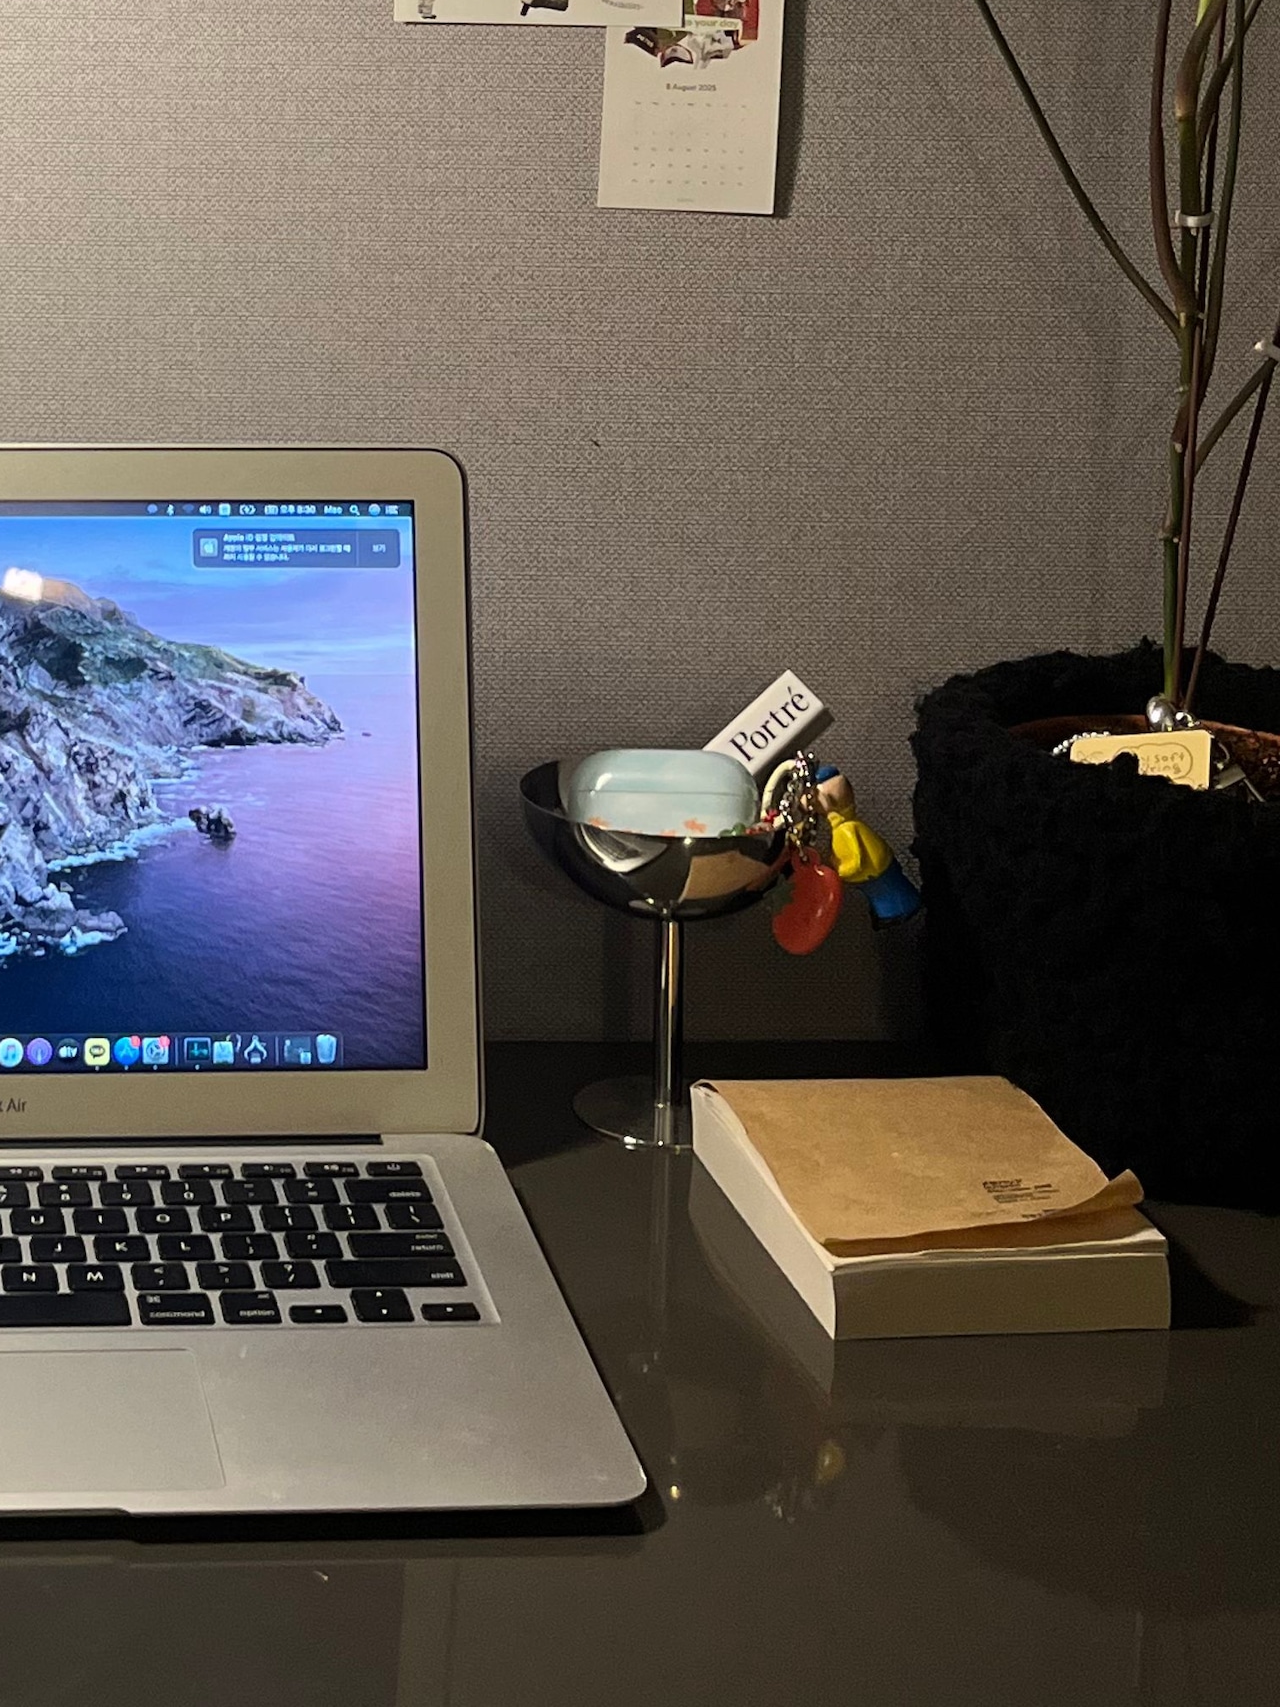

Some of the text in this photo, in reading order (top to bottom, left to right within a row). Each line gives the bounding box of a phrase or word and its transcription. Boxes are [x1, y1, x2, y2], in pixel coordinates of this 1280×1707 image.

[695, 20, 719, 29] your
[719, 21, 739, 29] day
[729, 686, 810, 762] Portré
[1155, 751, 1185, 763] soft
[6, 1097, 27, 1113] Air
[30, 1215, 44, 1225] U
[156, 1213, 170, 1223] O
[220, 1212, 231, 1222] P
[54, 1242, 62, 1252] J
[115, 1241, 128, 1252] K
[180, 1241, 191, 1251] L
[22, 1271, 36, 1282] N
[86, 1271, 104, 1281] M
